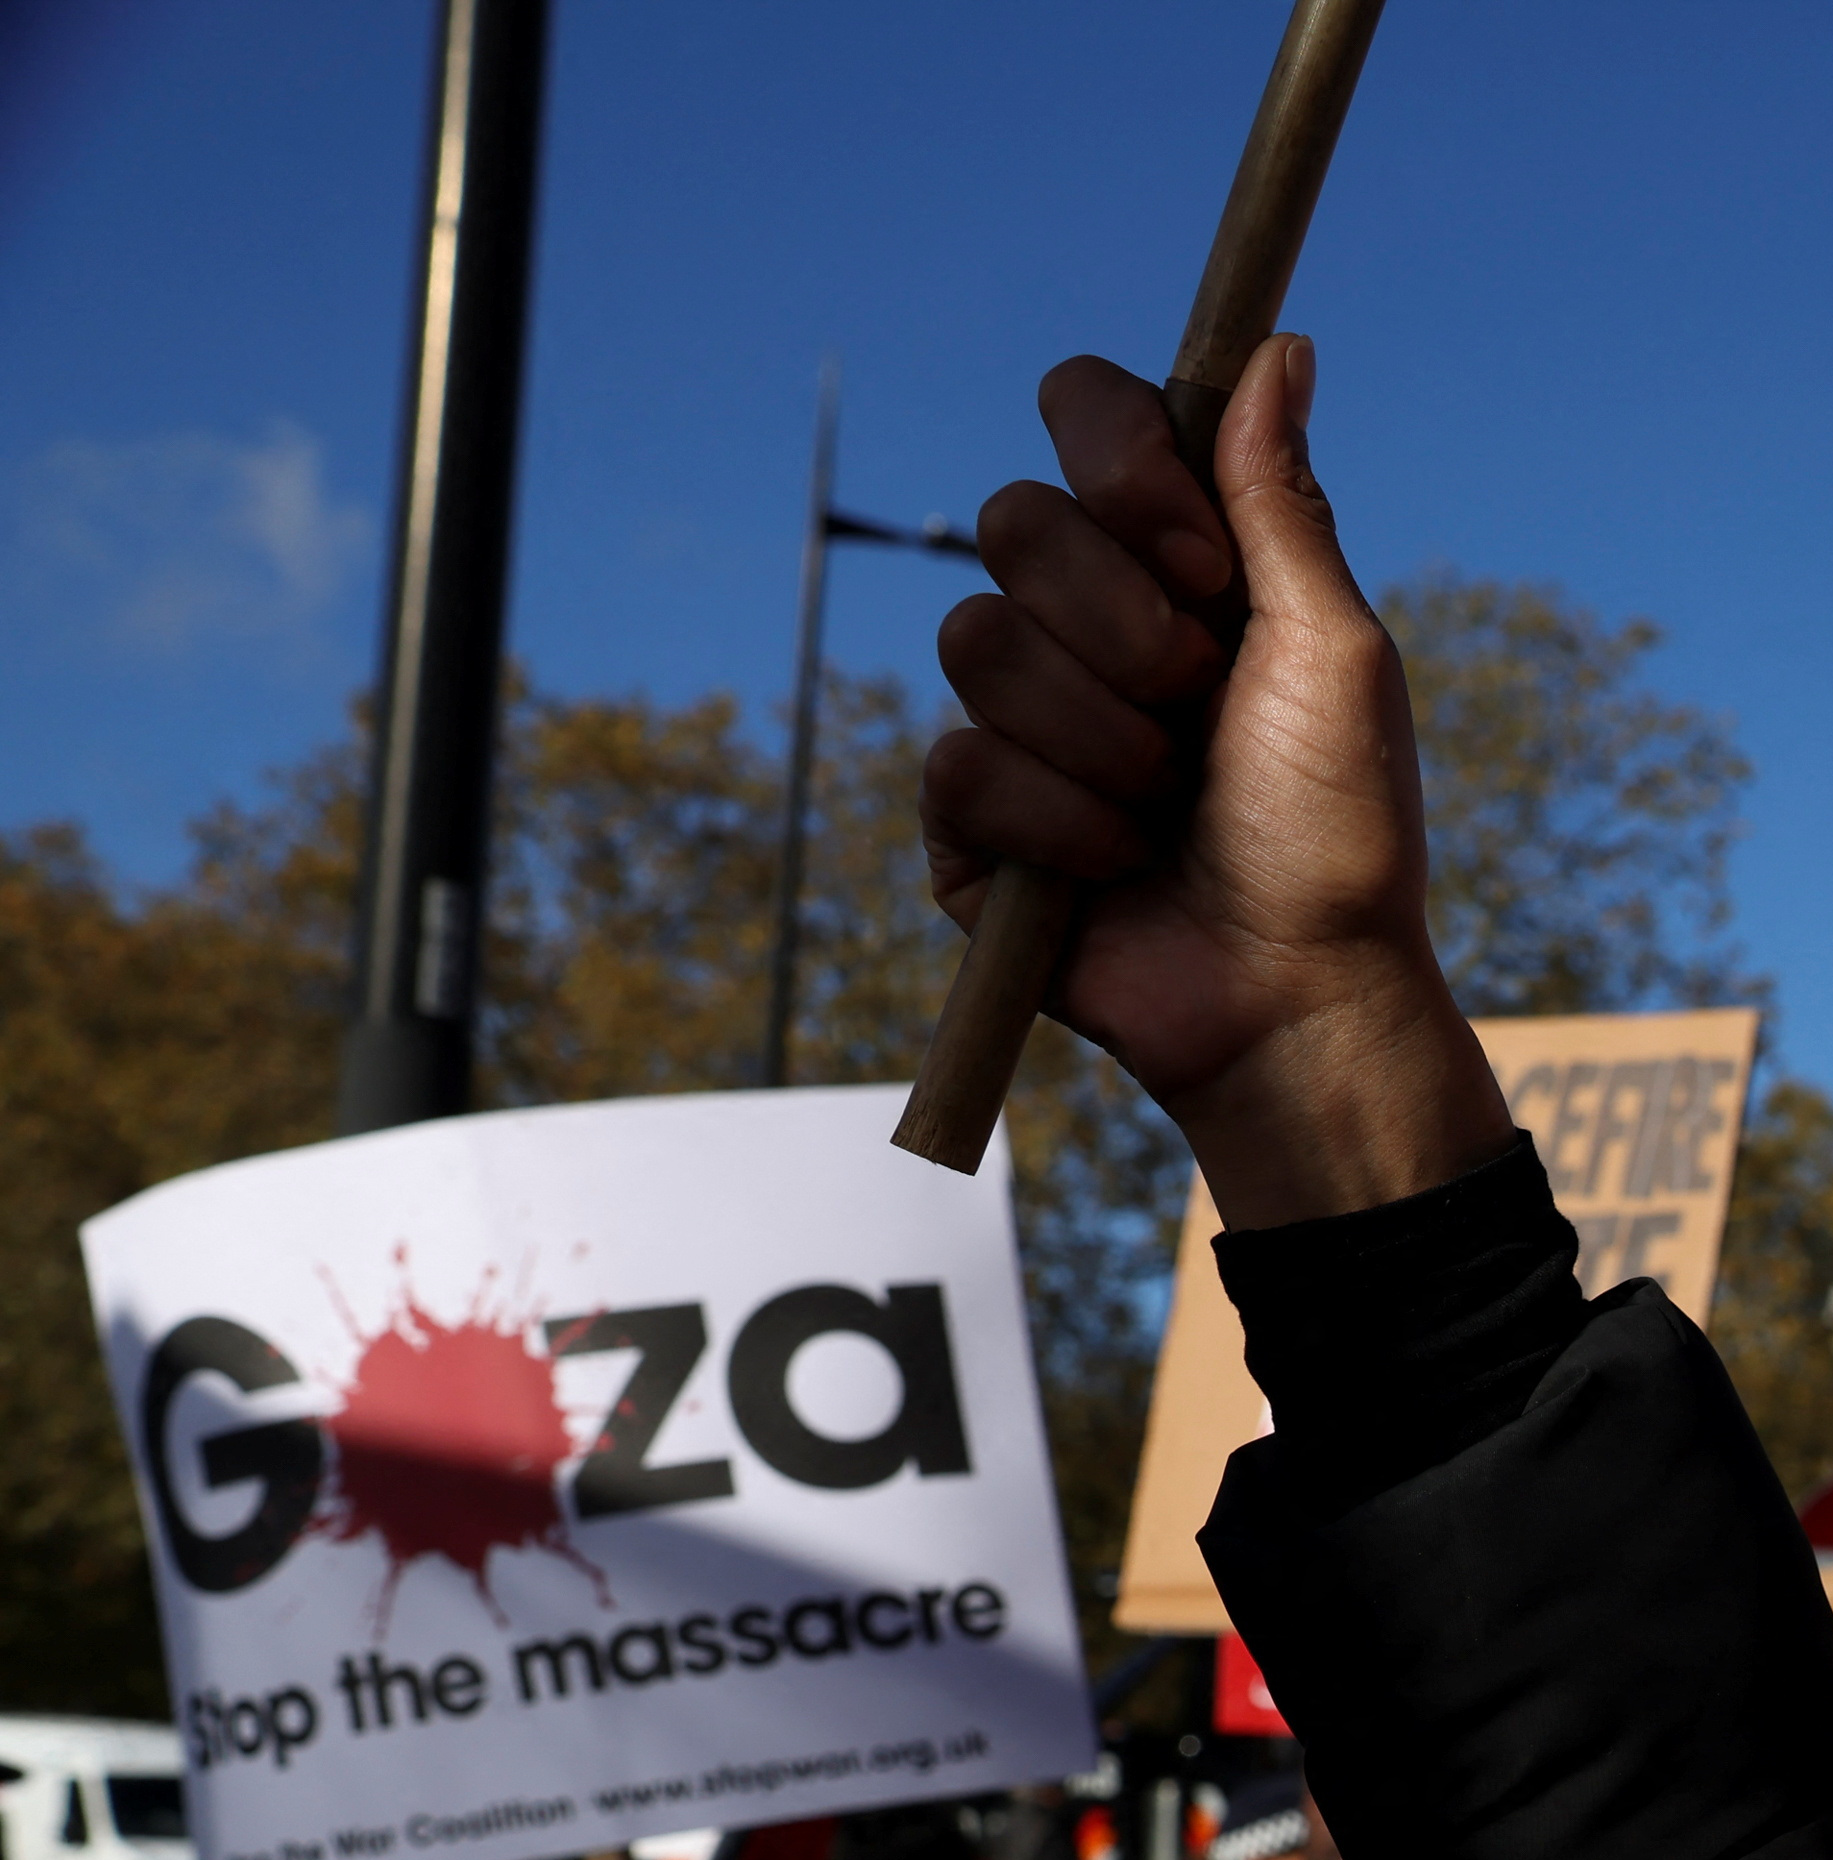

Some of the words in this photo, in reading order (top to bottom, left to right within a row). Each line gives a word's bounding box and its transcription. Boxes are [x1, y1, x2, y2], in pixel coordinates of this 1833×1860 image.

[140, 1280, 975, 1594] Gza
[337, 1651, 488, 1738] the
[513, 1579, 1005, 1703] massacre
